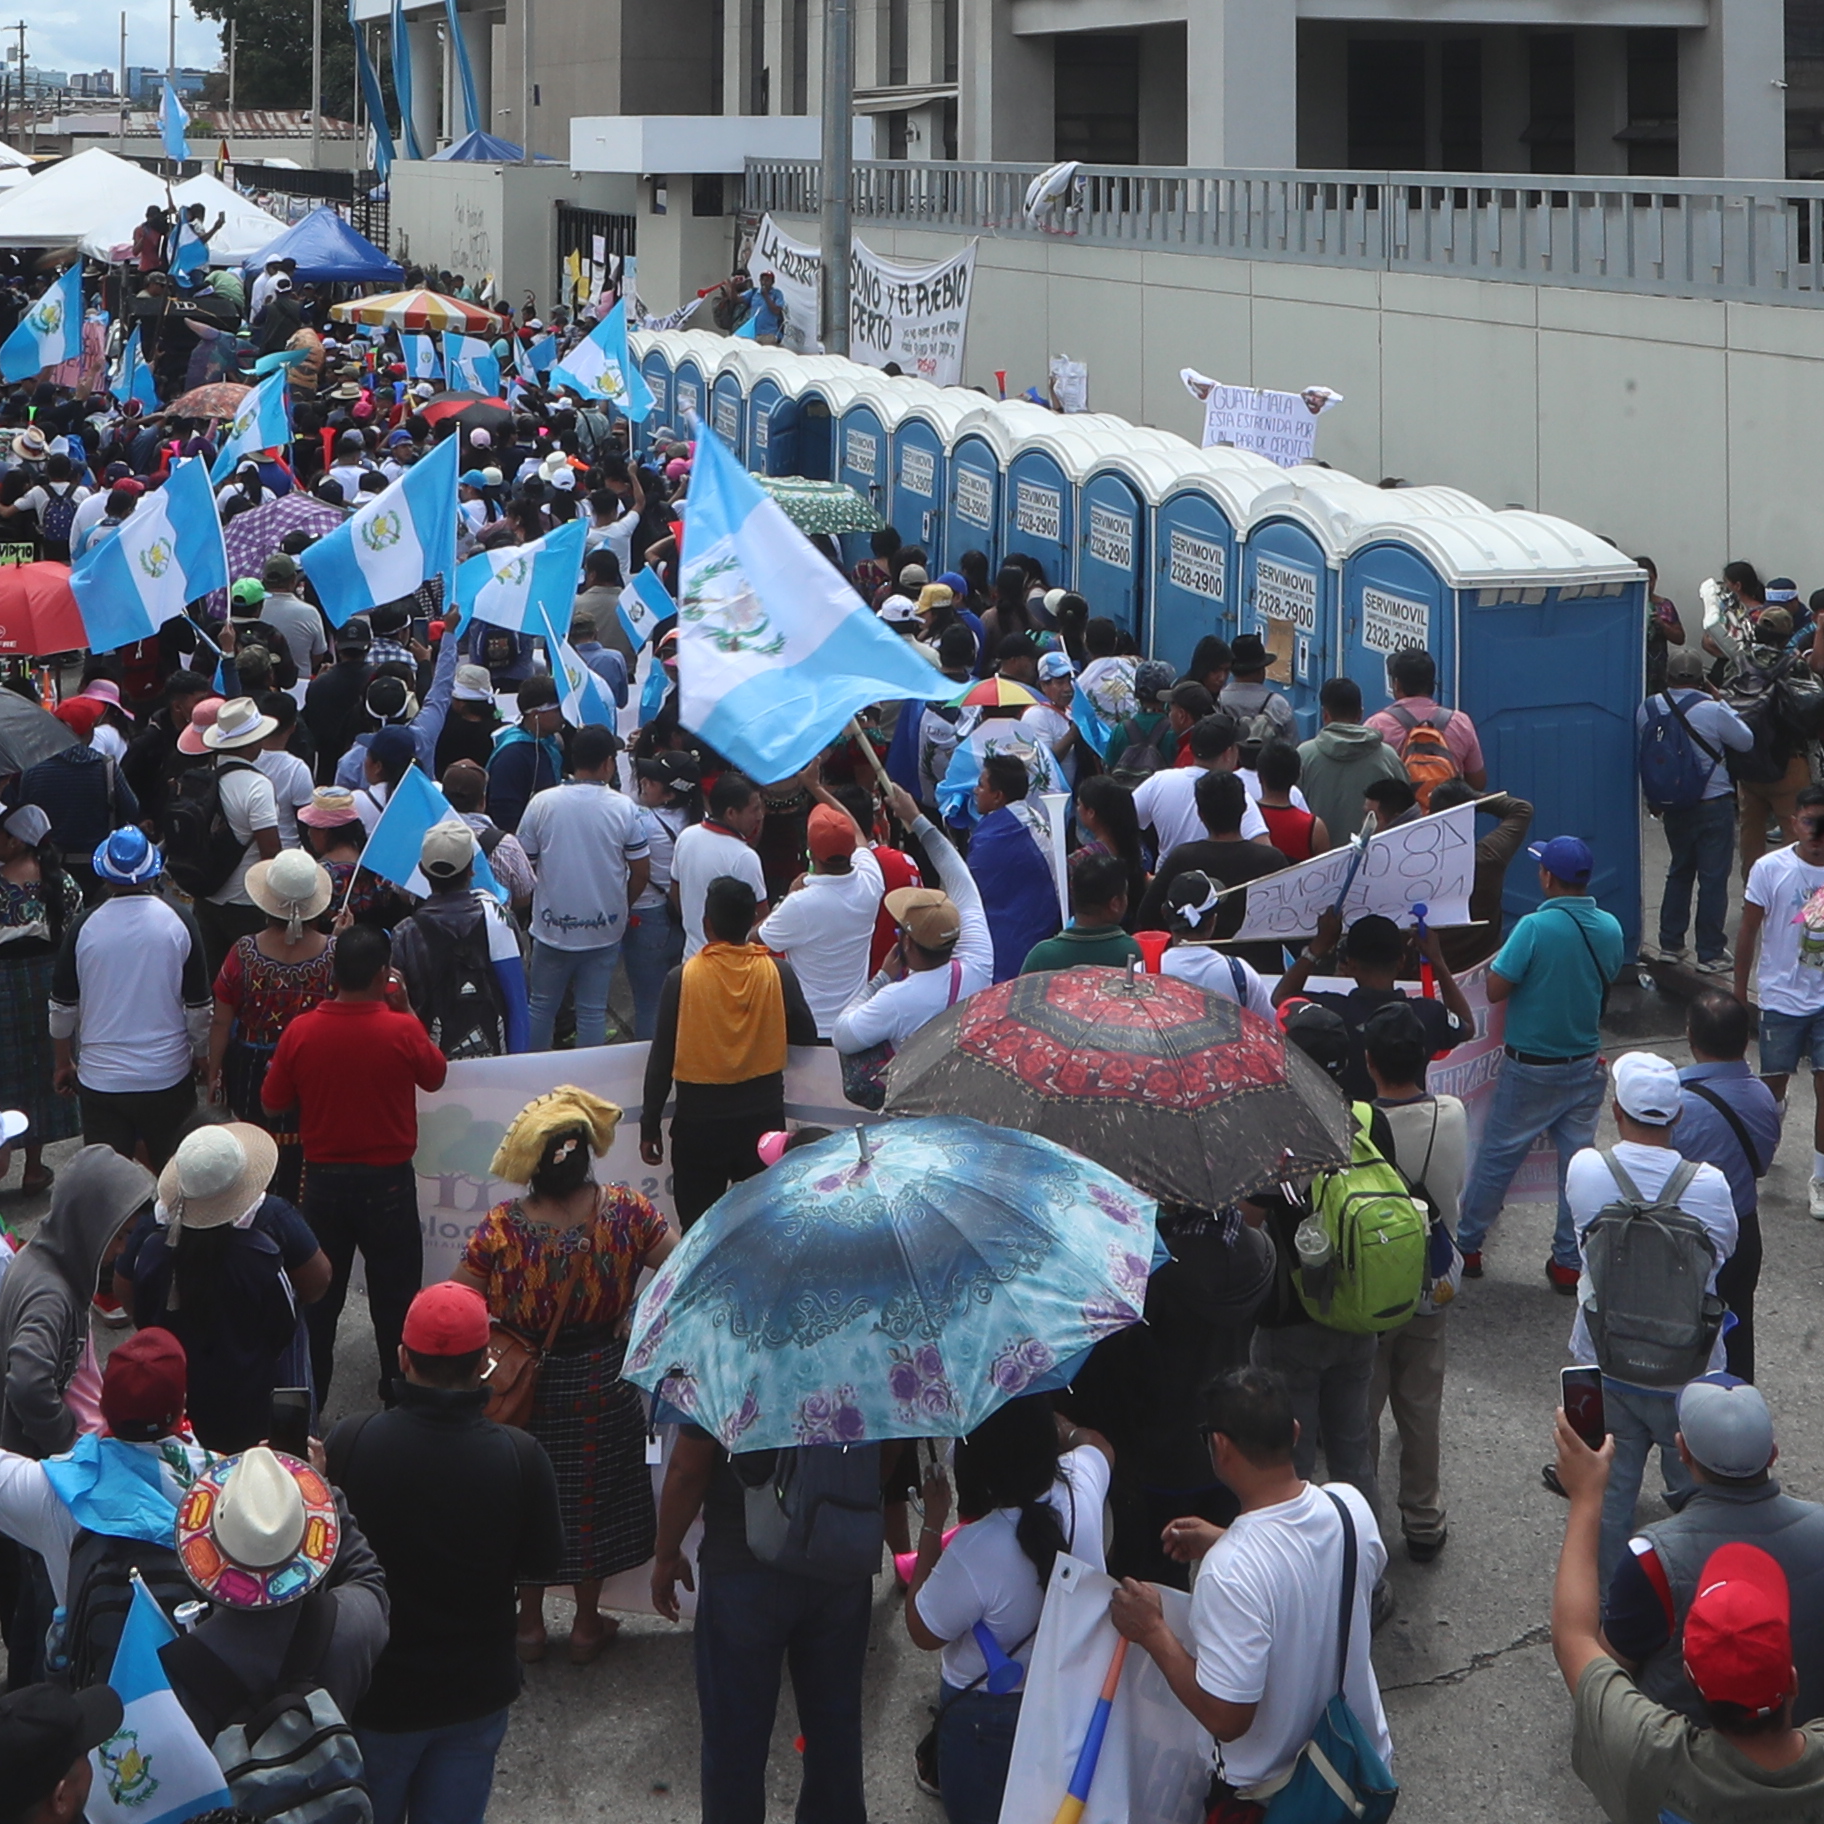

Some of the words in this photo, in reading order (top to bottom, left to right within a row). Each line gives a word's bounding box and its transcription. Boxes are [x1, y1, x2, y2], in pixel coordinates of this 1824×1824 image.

[761, 224, 779, 270] LA
[1209, 411, 1235, 427] ESTA
[1295, 421, 1314, 438] POR
[1017, 486, 1060, 509] SERVIMOVIL
[1017, 509, 1059, 537] 2328-2900
[1090, 509, 1132, 537] SERVIMOVIL
[1090, 534, 1131, 567] 2328-2900
[1170, 534, 1224, 566] SERVIMOVIL
[1170, 560, 1223, 597] 2328-2900
[1256, 561, 1315, 596] SERVIMOVIL
[1257, 591, 1314, 629] 2328-2900
[1364, 591, 1427, 627] SERVIMOVIL
[1365, 620, 1426, 653] 2328-2900
